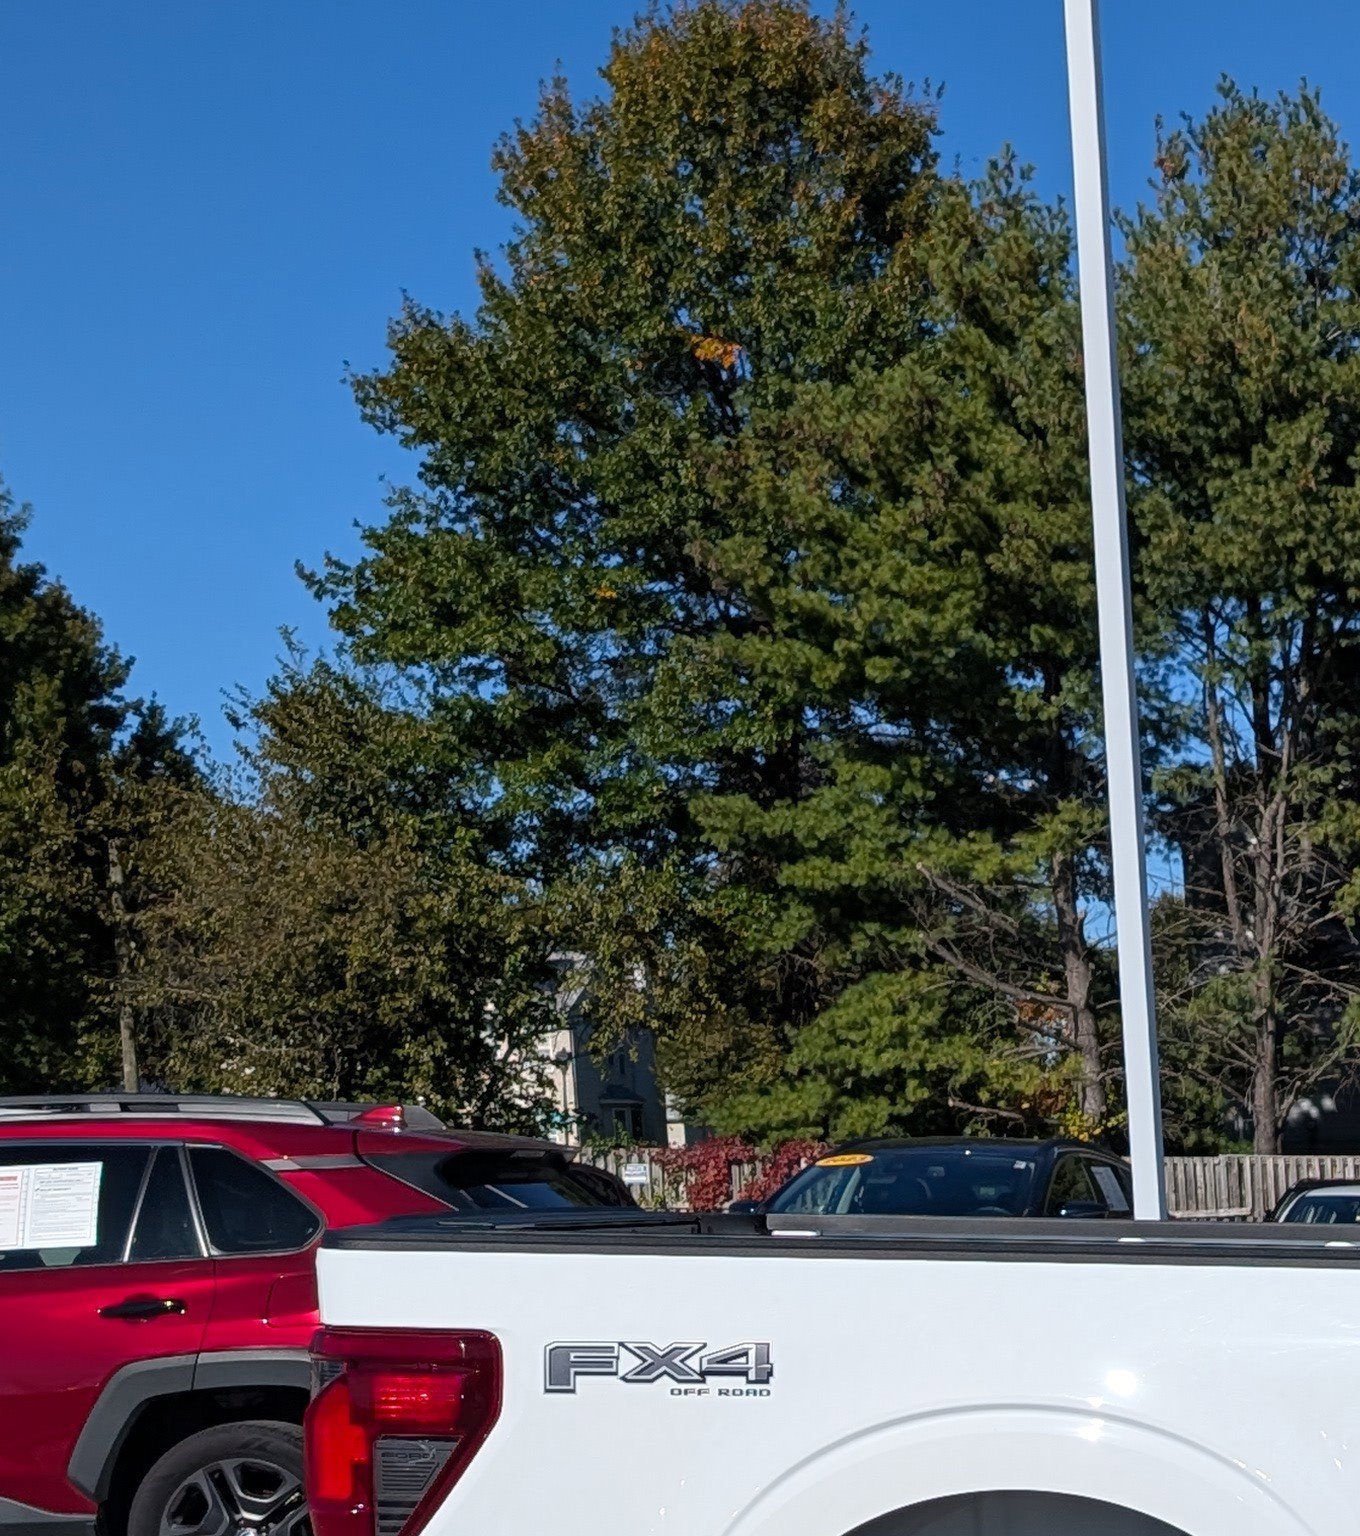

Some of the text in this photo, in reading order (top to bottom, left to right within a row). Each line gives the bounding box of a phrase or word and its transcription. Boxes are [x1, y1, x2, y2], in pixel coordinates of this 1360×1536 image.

[544, 1341, 774, 1394] FX4
[669, 1387, 772, 1398] OFF ROAD
